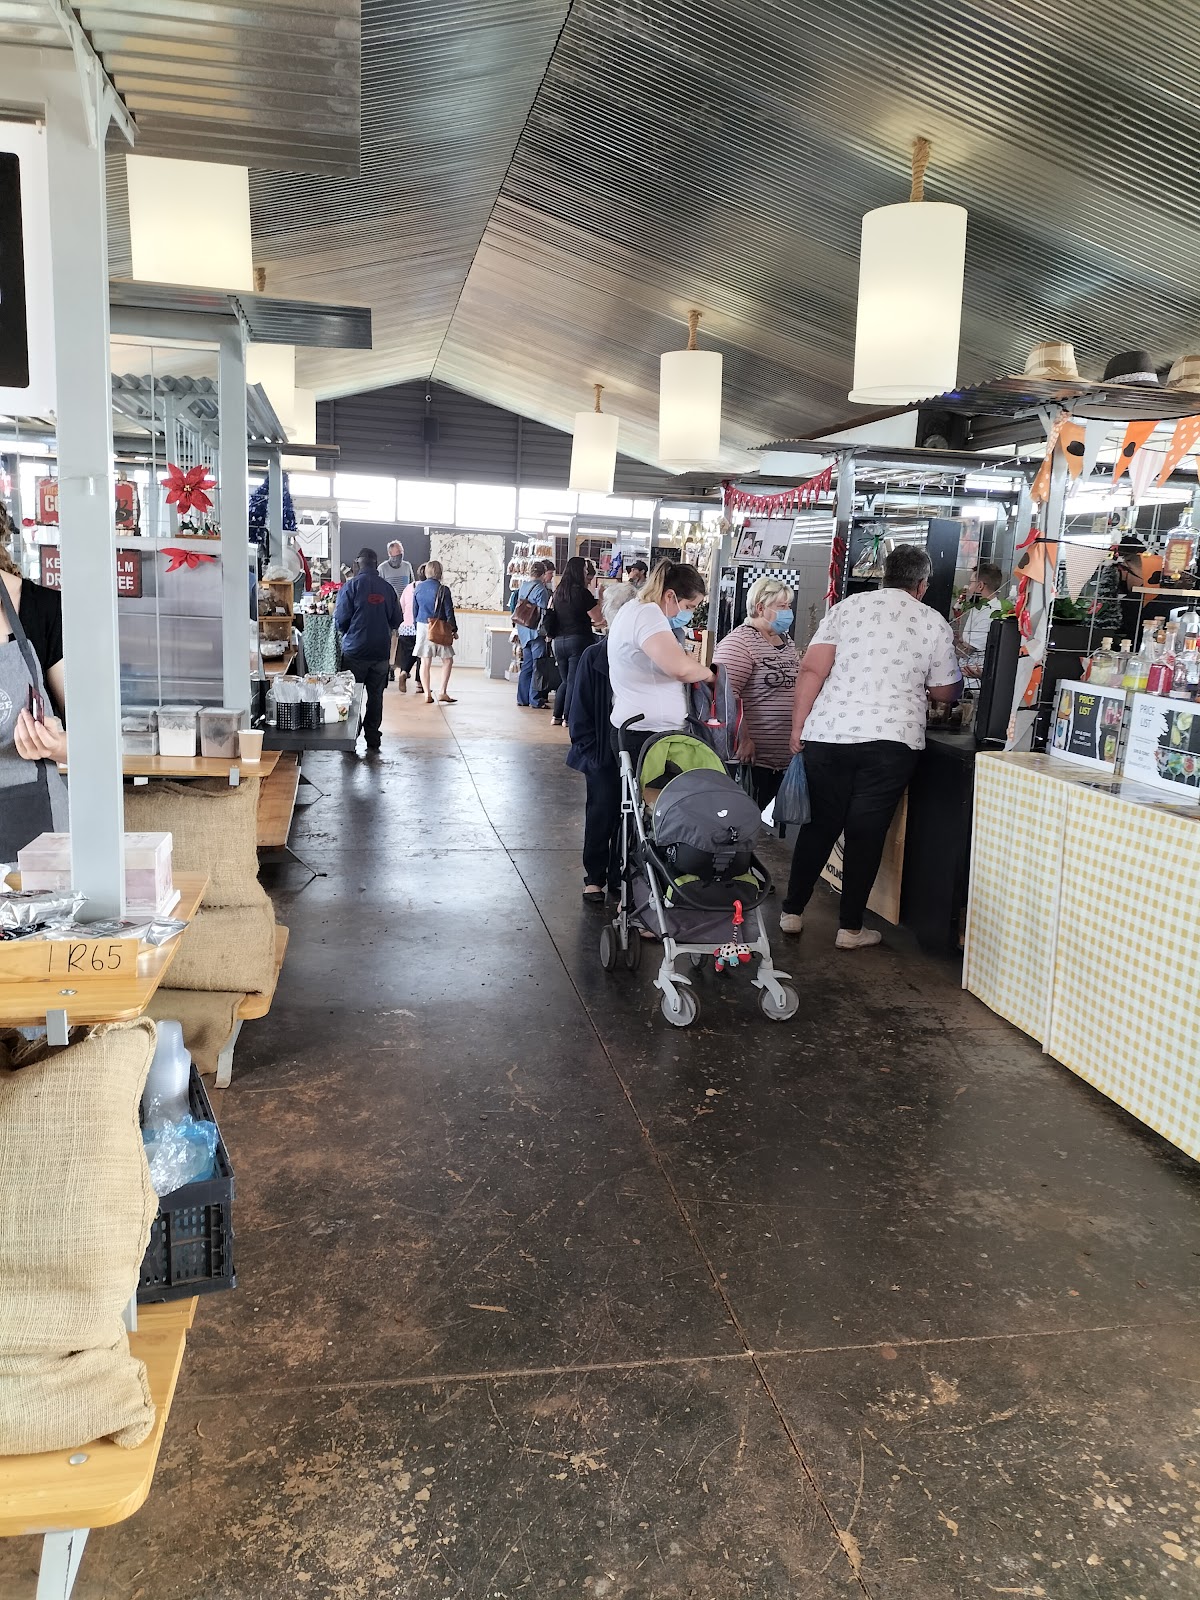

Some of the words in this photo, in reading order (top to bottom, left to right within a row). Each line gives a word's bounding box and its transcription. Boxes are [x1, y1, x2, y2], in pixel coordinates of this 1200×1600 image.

[1079, 695, 1095, 706] PRICE
[1079, 706, 1092, 715] LIST
[1140, 704, 1156, 716] PRICE
[1140, 717, 1152, 728] LIST
[68, 943, 122, 972] R65
